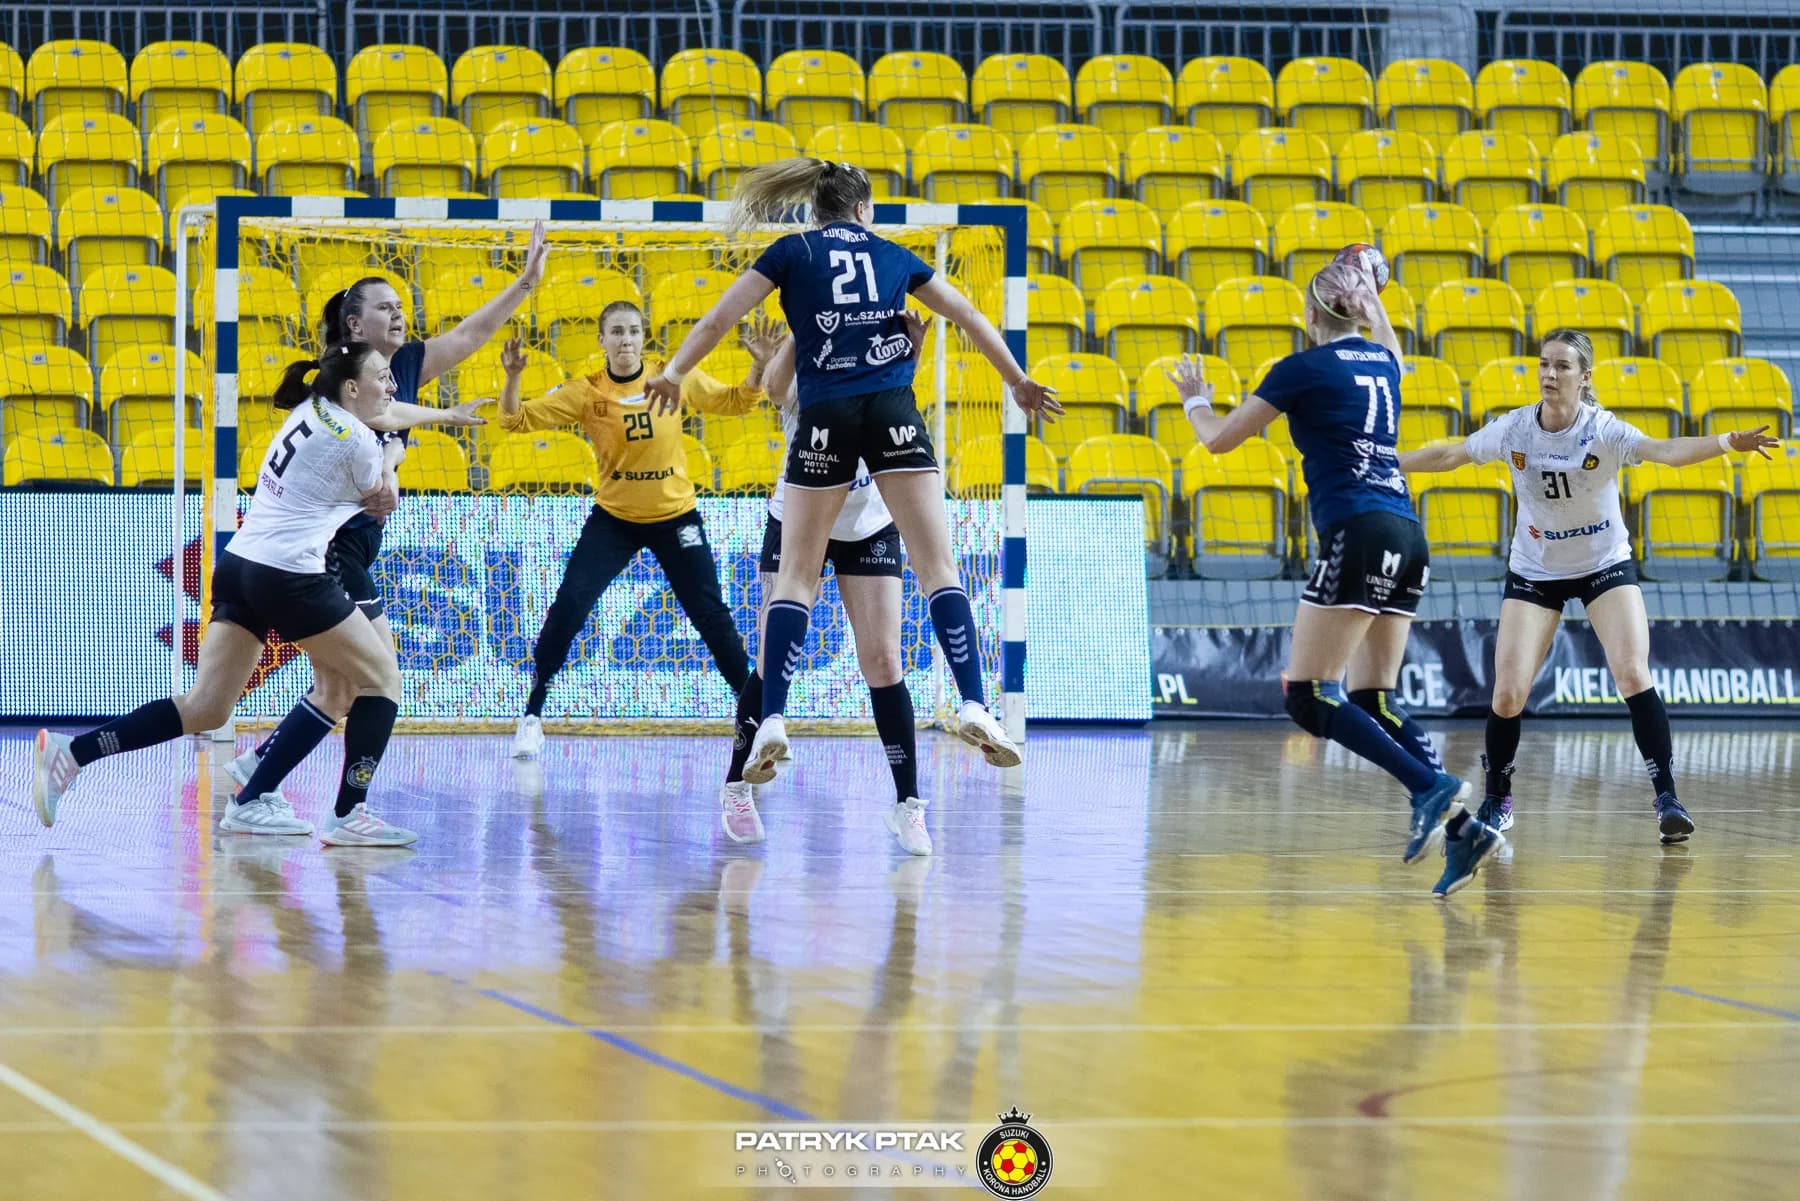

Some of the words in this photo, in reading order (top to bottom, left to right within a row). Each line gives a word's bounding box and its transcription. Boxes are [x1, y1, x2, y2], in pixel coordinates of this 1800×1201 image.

[829, 249, 879, 304] 21
[875, 339, 905, 360] LOTTO
[1354, 375, 1395, 434] 71
[624, 412, 654, 441] 29
[268, 419, 313, 479] 5
[798, 450, 840, 463] UNITRAL
[804, 461, 829, 469] HOTEL
[1541, 471, 1572, 499] 31
[1543, 519, 1610, 540] SUZUKI
[860, 557, 897, 565] PROFIKA
